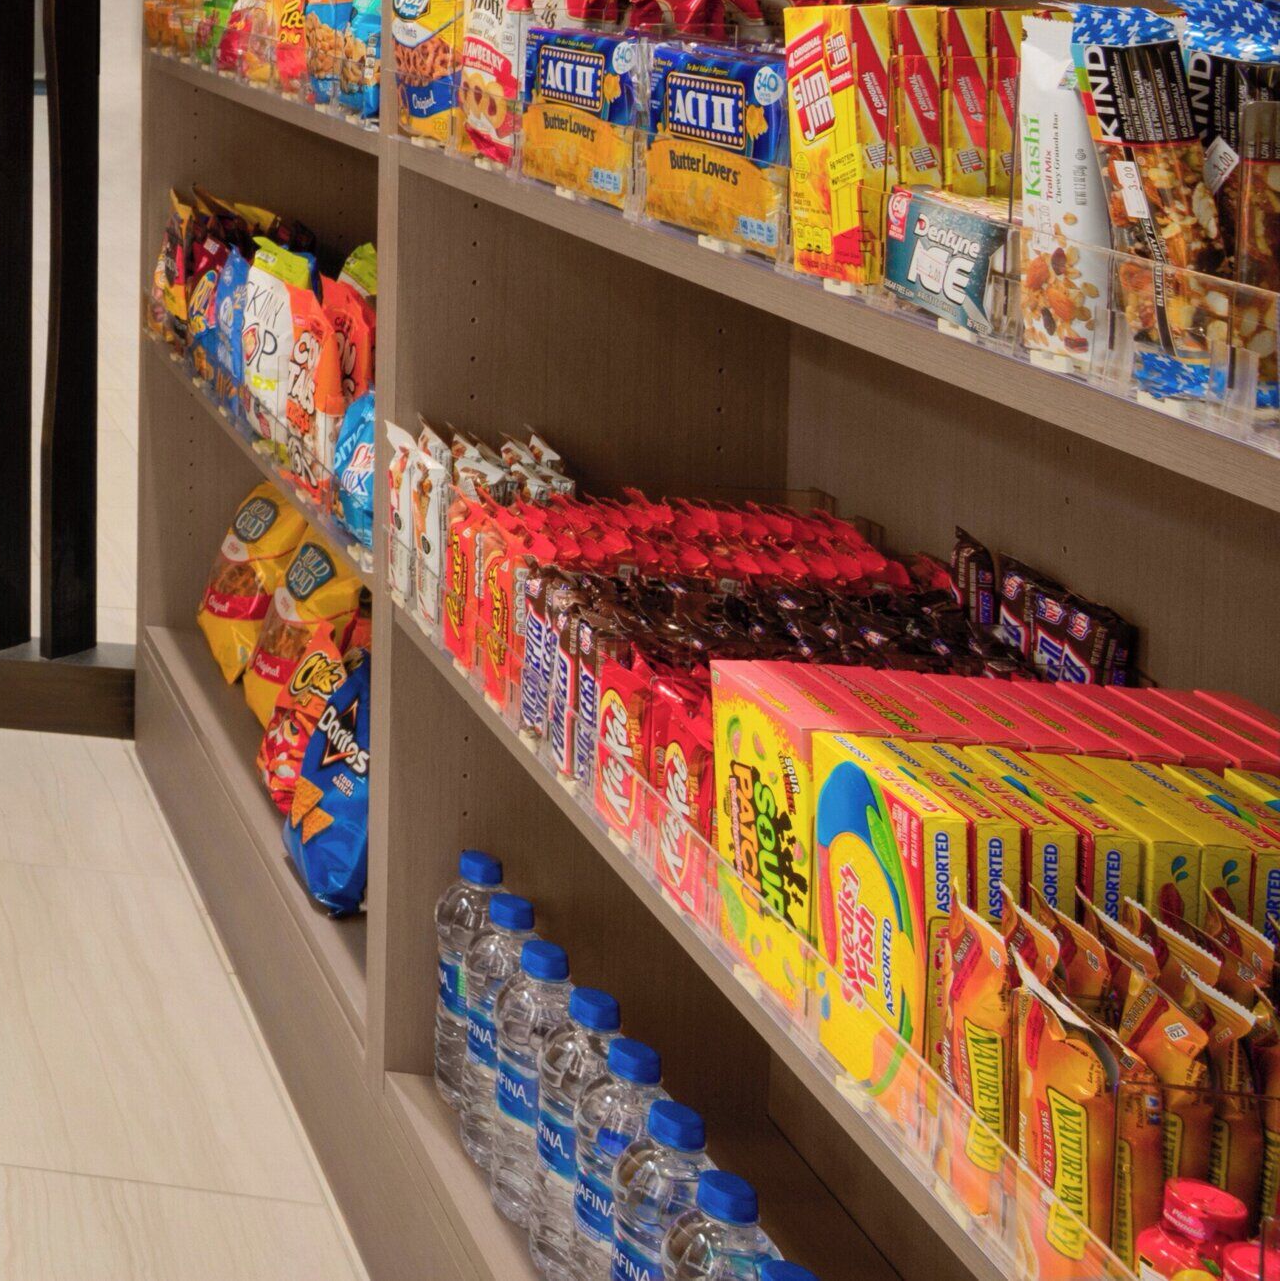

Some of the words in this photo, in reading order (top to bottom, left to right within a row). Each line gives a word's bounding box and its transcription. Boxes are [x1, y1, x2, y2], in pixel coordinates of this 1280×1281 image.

[545, 61, 573, 94] ACT
[755, 73, 779, 92] 340
[792, 70, 830, 110] slim
[862, 72, 881, 108] ORIGINAL
[908, 73, 934, 111] ORIGINAL
[960, 75, 981, 113] ORIGINAL
[1084, 44, 1123, 143] KIND
[543, 110, 568, 132] Butter
[568, 120, 595, 142] Lovers
[673, 89, 710, 126] ACT
[669, 150, 700, 173] Butter
[701, 161, 739, 187] Lovers
[1024, 117, 1041, 199] Kashi
[1045, 149, 1054, 168] Mix
[1045, 169, 1054, 201] Trail
[914, 213, 981, 259] Dentyne
[318, 705, 370, 775] Doritos
[606, 700, 635, 776] Kat
[338, 772, 355, 790] COOL
[602, 757, 631, 826] Kit
[784, 755, 802, 796] SOUR
[731, 761, 763, 918] PATCH
[753, 780, 787, 928] SOUR
[937, 830, 951, 914] ASSORTED
[988, 836, 1004, 919] ASSORTED
[837, 862, 864, 1011] Swedish
[859, 902, 879, 996] Fish
[882, 917, 894, 1017] ASSORTED
[969, 1025, 1000, 1108] NATURE
[1040, 1109, 1052, 1141] SWEET
[1051, 1096, 1084, 1183] NATURE
